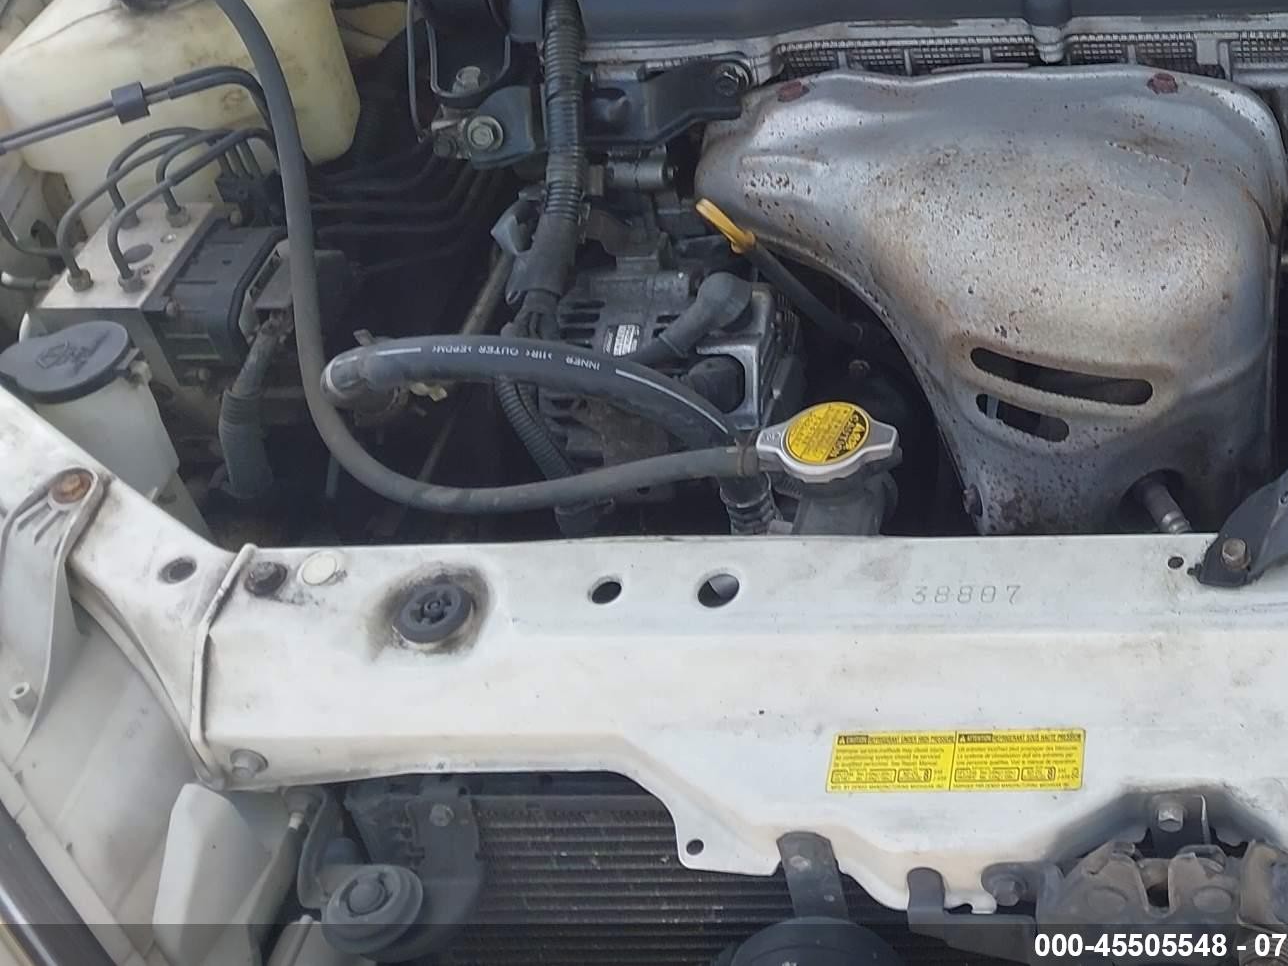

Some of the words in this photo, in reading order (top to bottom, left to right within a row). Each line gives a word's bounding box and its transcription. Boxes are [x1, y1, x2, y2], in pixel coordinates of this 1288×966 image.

[478, 344, 519, 357] OUTER
[565, 355, 601, 371] INNER
[911, 584, 1022, 606] 38807
